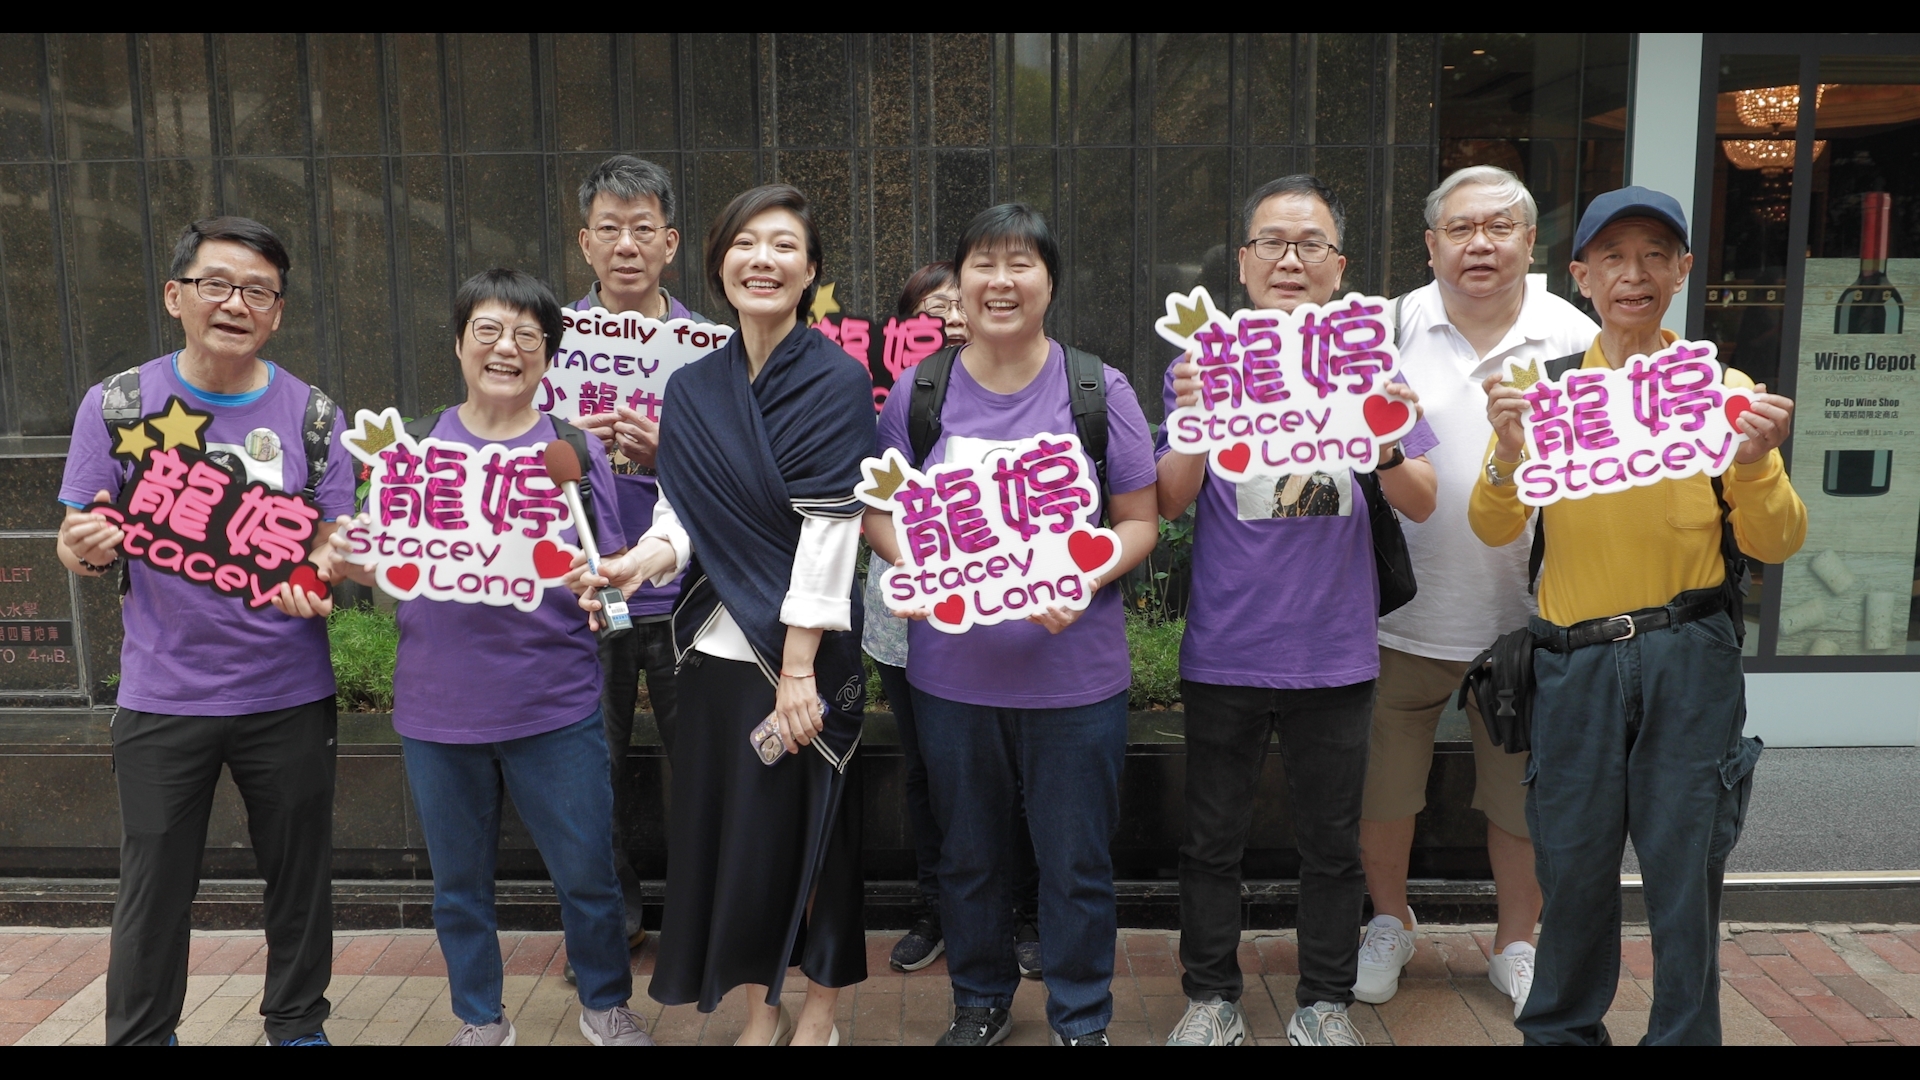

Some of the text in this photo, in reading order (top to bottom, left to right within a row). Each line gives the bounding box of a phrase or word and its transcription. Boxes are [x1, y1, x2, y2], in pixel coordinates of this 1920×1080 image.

[673, 325, 727, 350] for
[1193, 300, 1394, 412] 龍婷
[1815, 352, 1917, 373] Wine Depot
[1522, 345, 1723, 461] 龍婷
[1825, 398, 1900, 408] Pop-Up Wine Shop
[1177, 407, 1332, 444] Stacey
[1261, 437, 1372, 467] Long
[1521, 432, 1732, 499] Stacey
[128, 447, 320, 570] 龍婷
[378, 442, 569, 539] 龍婷
[893, 439, 1091, 567] 龍婷
[345, 527, 501, 567] Stacey
[428, 564, 536, 603] Long
[889, 547, 1034, 601] Stacey
[973, 573, 1084, 617] Long
